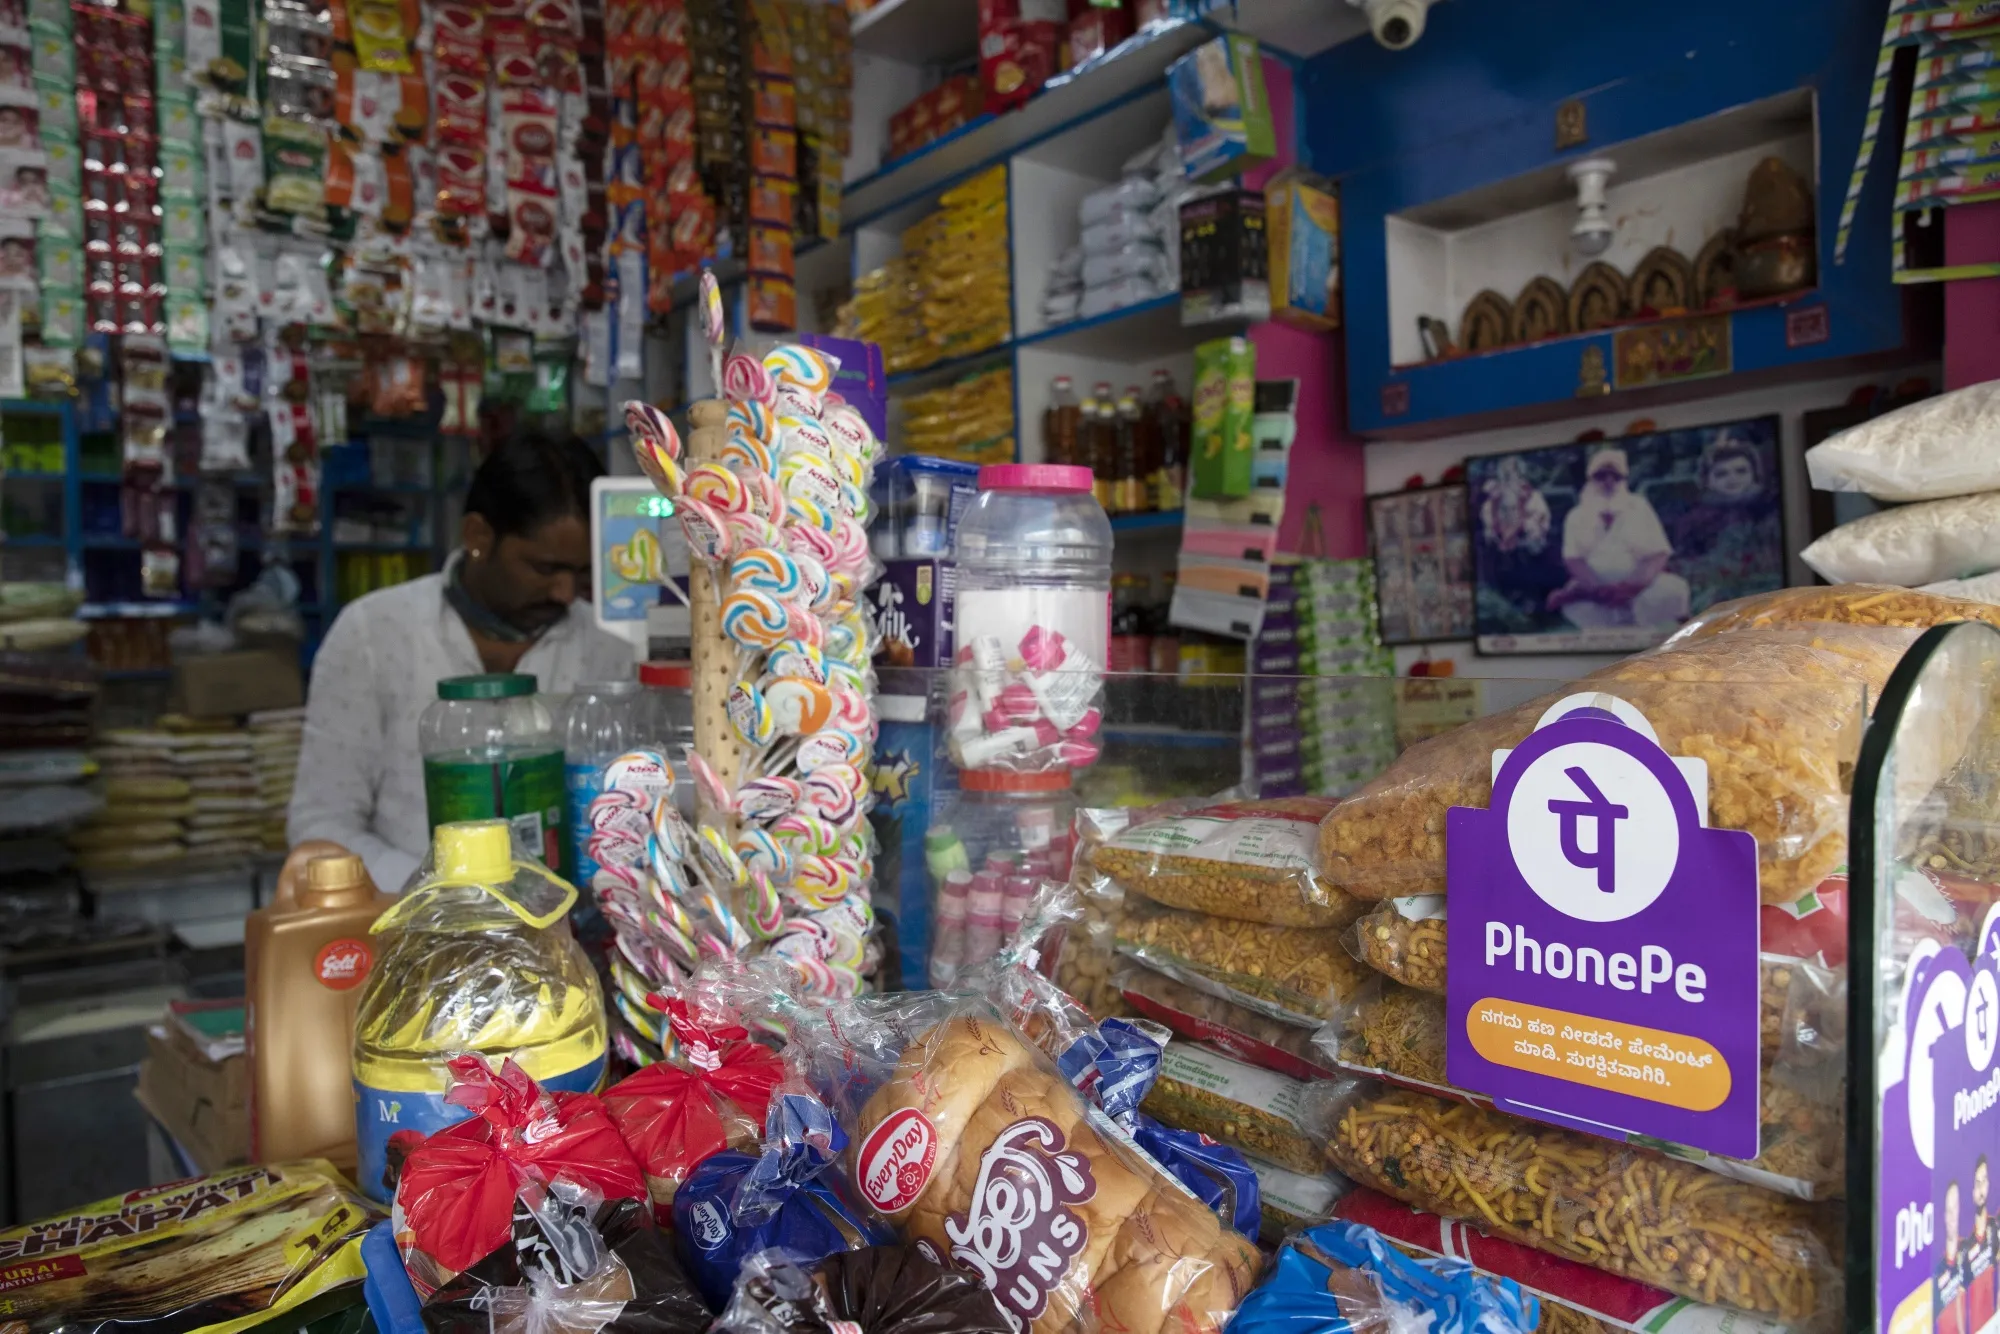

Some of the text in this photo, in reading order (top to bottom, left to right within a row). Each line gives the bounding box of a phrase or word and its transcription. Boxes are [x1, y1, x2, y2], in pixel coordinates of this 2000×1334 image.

[1548, 766, 1629, 893] पे
[1485, 921, 1707, 1003] PhonePe
[1481, 1009, 1522, 1030] ನಗದು
[1527, 1019, 1555, 1037] ಹಣ
[1560, 1025, 1622, 1051] ನೀಡದೇ
[1514, 1040, 1561, 1063] ಮಾಡಿ.
[1175, 1061, 1230, 1085] Condiments
[867, 1118, 923, 1199] EveryDay
[892, 1140, 937, 1209] Eat Fresh
[31, 1204, 156, 1234] whole
[0, 1262, 64, 1281] URAL
